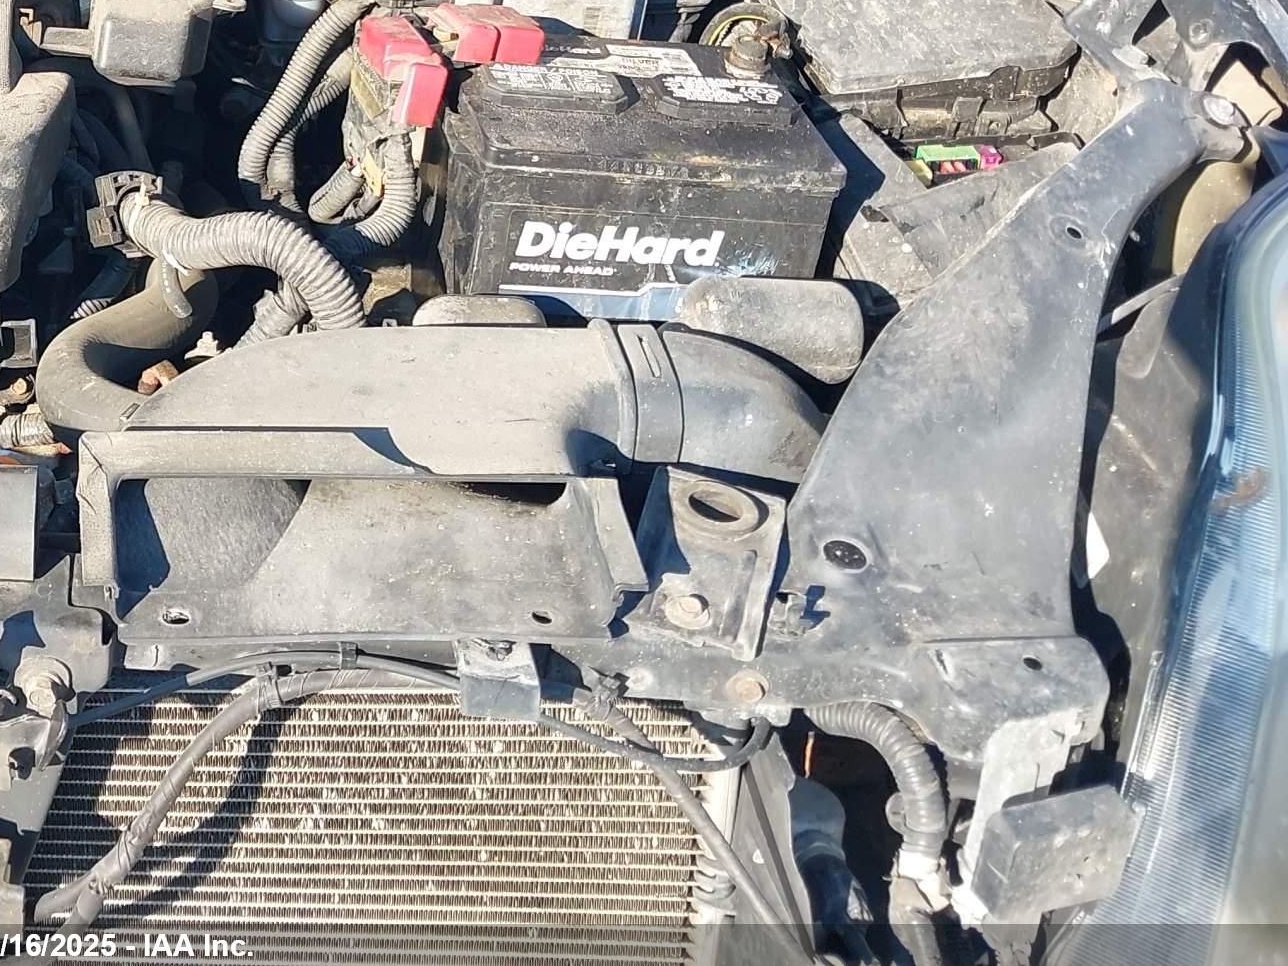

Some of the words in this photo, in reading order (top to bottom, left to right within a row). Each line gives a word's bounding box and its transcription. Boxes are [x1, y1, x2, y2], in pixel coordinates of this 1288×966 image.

[515, 220, 725, 267] DieHard
[509, 262, 561, 273] POWER
[563, 265, 614, 276] AHEAD
